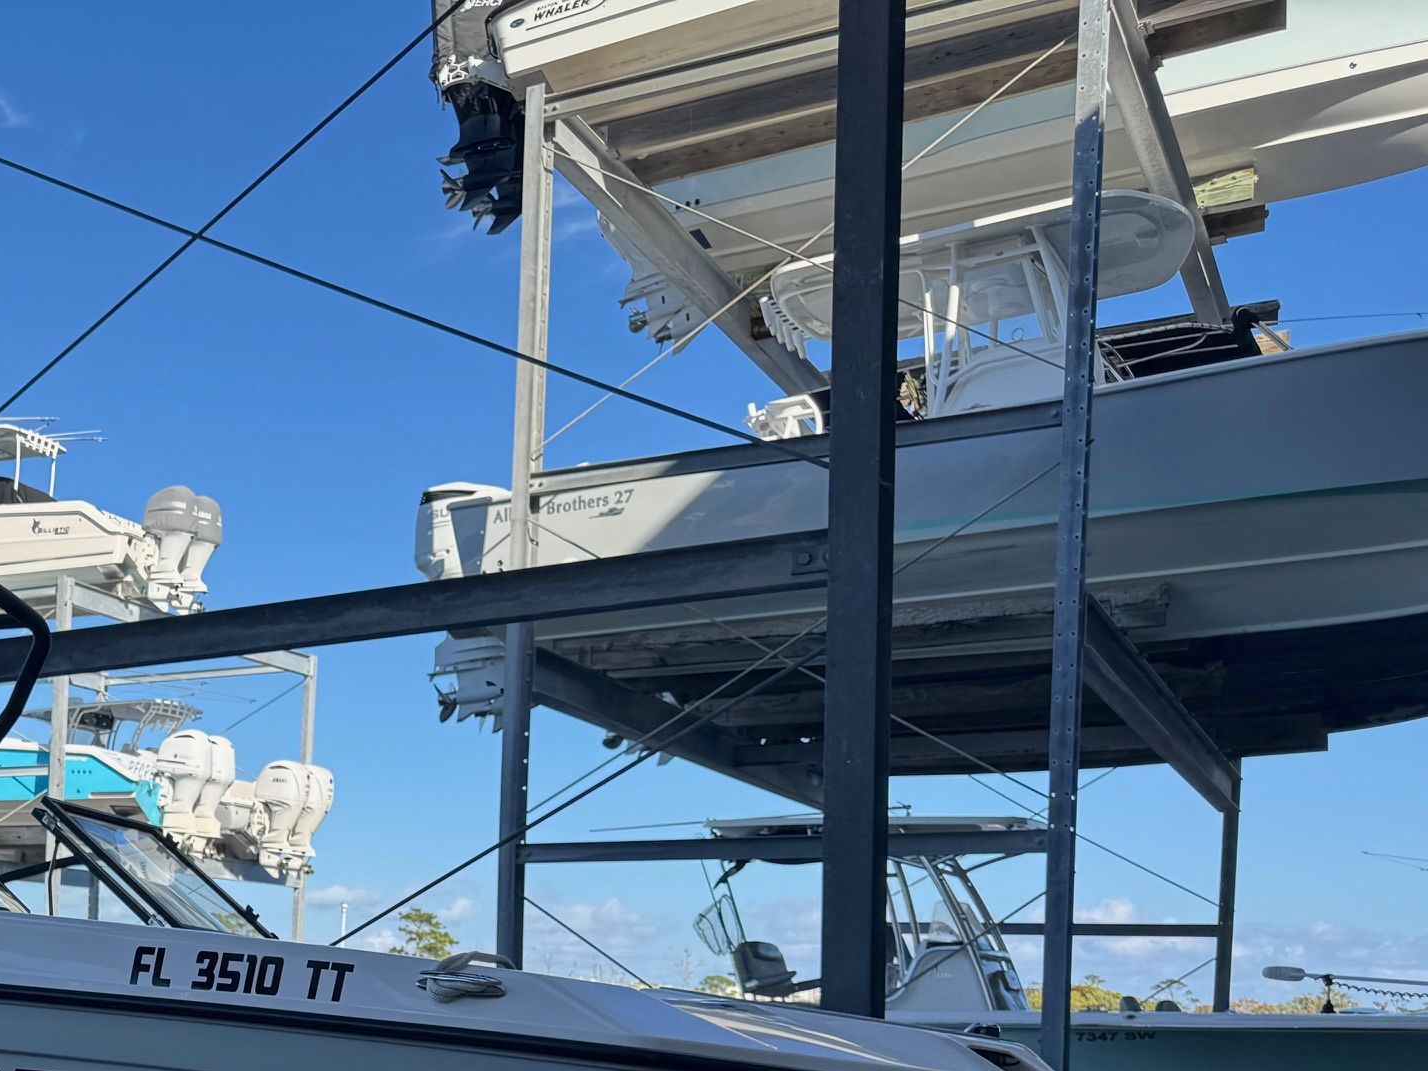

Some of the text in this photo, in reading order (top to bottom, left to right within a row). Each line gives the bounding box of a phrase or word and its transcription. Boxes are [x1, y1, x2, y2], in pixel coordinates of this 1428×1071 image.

[534, 0, 590, 21] WHALER
[547, 489, 634, 515] Brothers 27
[129, 946, 355, 1002] FL 3510 TT
